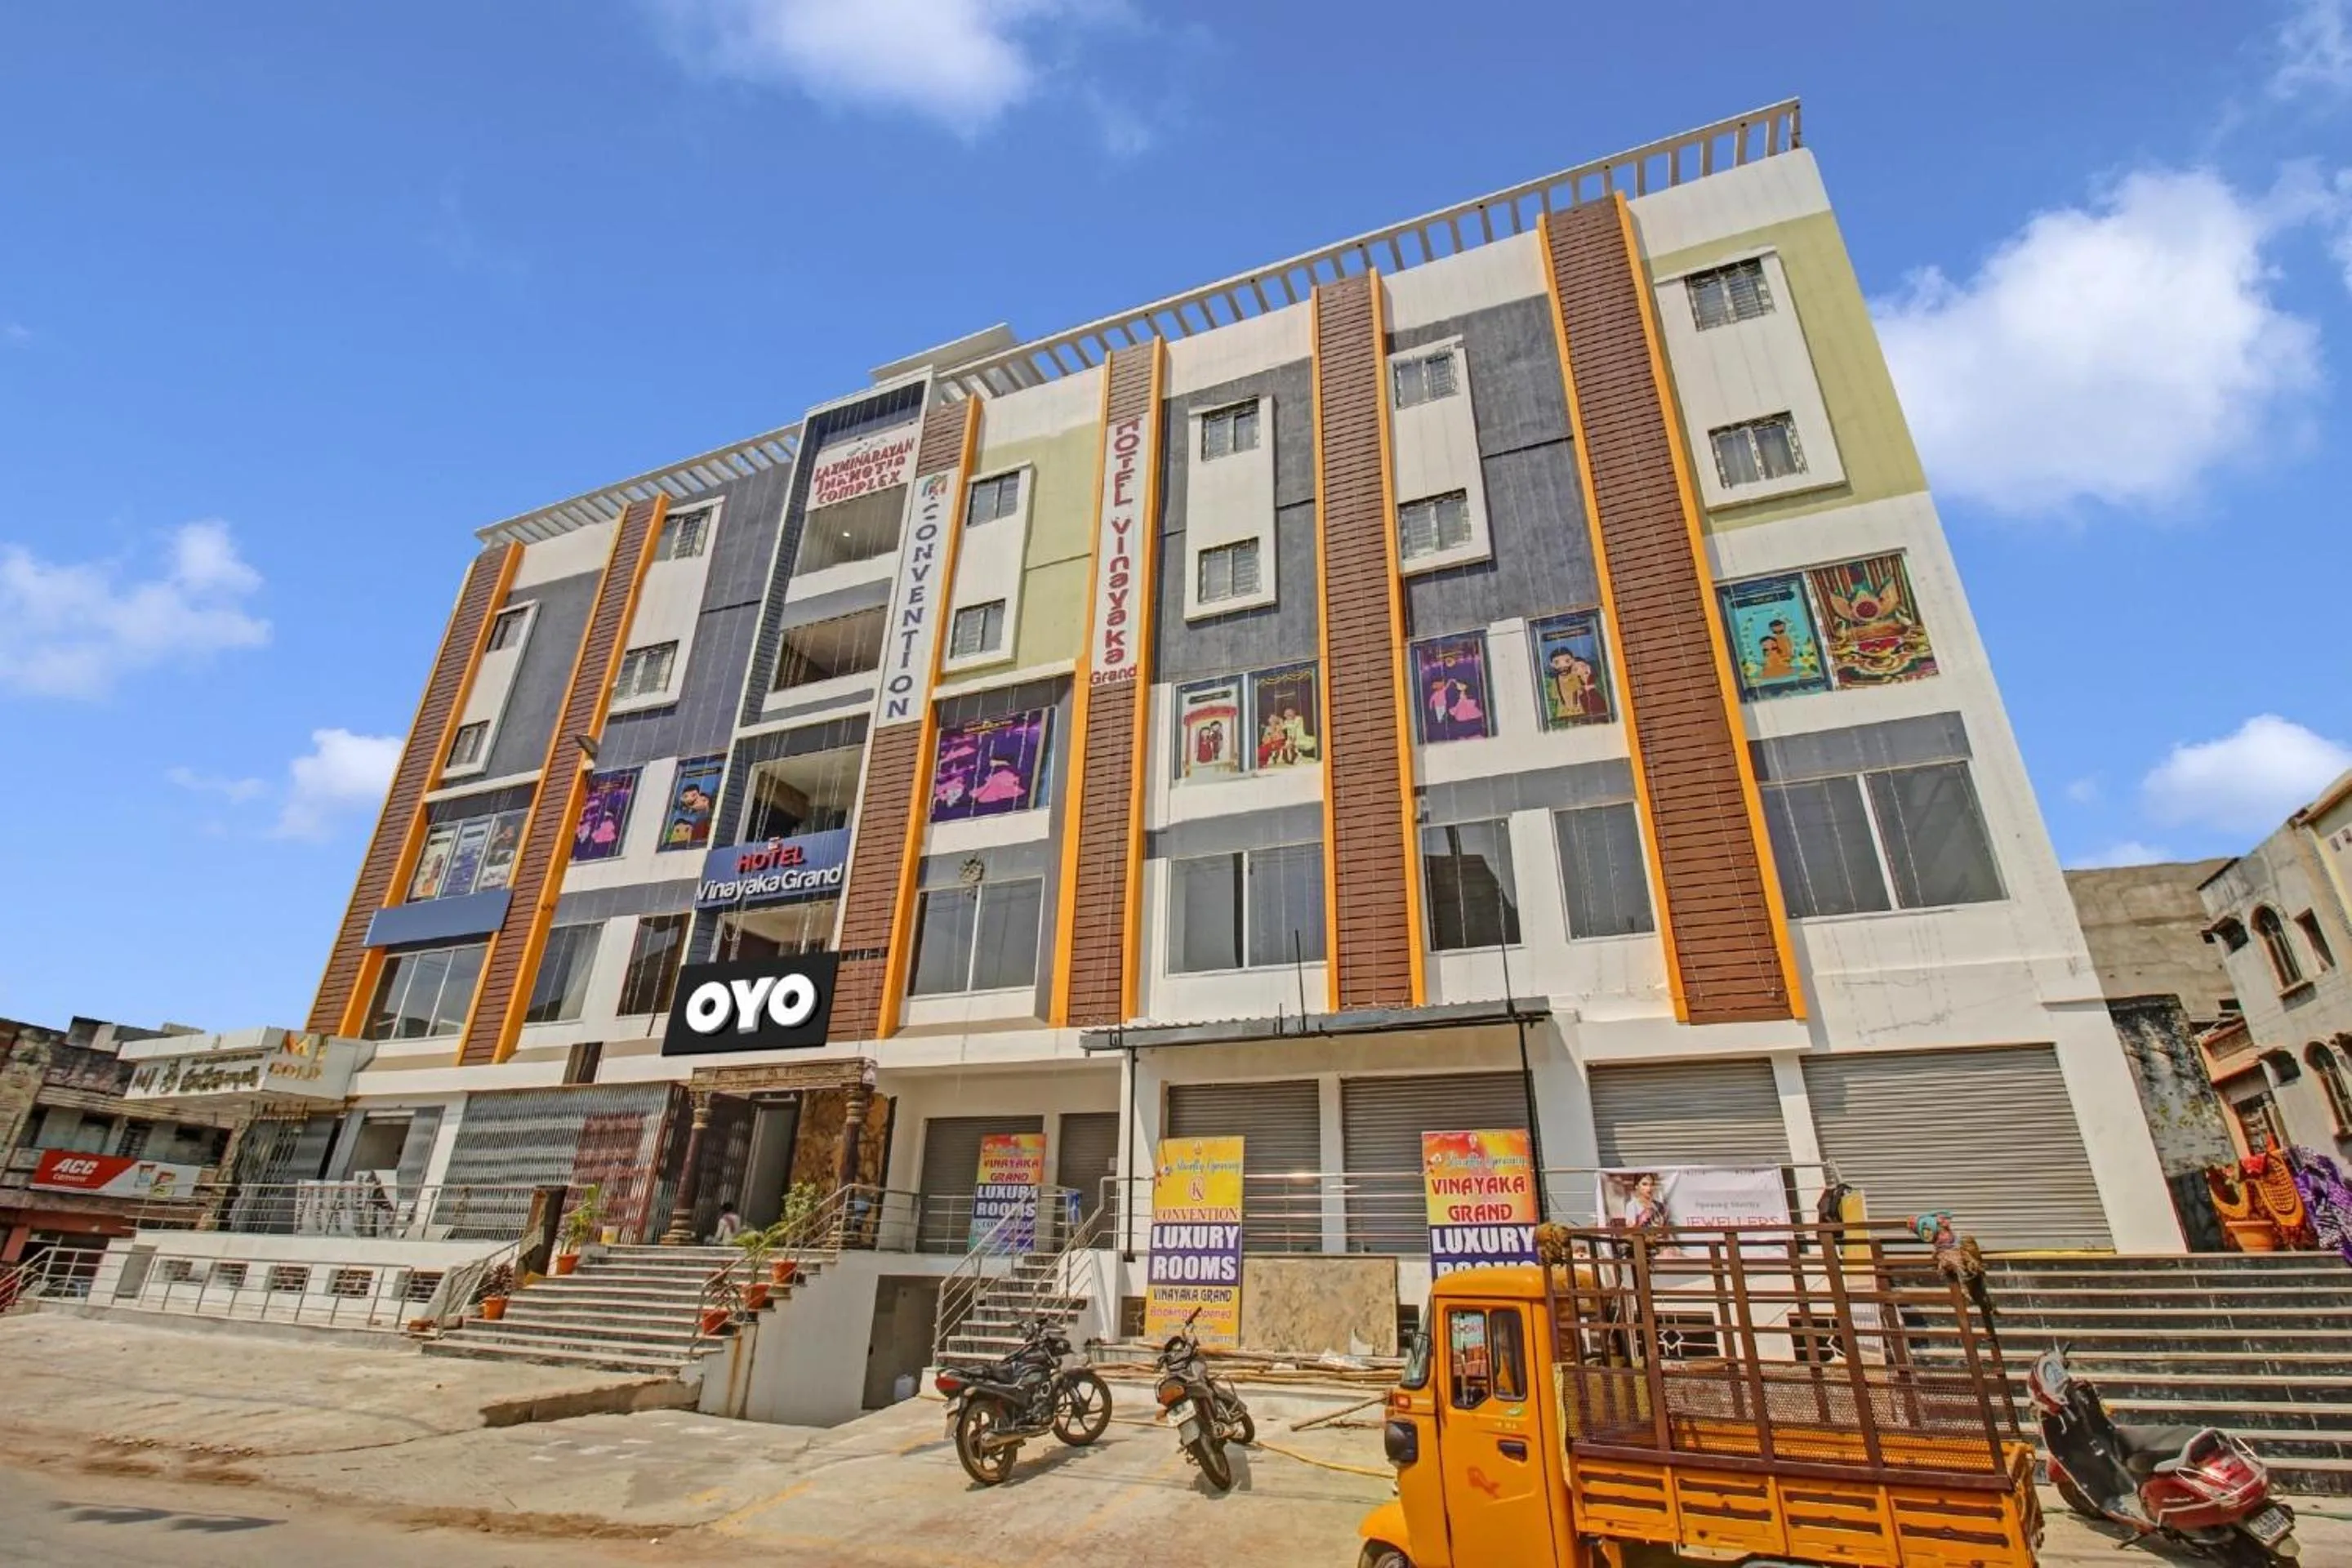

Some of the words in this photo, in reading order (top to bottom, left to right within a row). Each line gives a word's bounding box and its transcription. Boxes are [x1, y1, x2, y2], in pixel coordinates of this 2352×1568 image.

[817, 470, 901, 505] COMPLEX
[1090, 665, 1138, 685] Grand
[737, 845, 804, 873] HOTEL
[695, 874, 780, 901] Vinayaka
[782, 862, 844, 890] Grand
[686, 973, 817, 1035] OYO
[52, 1158, 99, 1175] ACC
[991, 1172, 1029, 1182] GRAND
[1431, 1176, 1525, 1196] VINAYAKA
[1155, 1207, 1239, 1221] CONVENTION
[1448, 1204, 1512, 1222] GRAND
[1152, 1226, 1240, 1249] LUXURY
[1432, 1227, 1536, 1254] LUXURY
[1152, 1255, 1236, 1281] ROOMS
[1154, 1288, 1199, 1301] VINAYAKA
[1200, 1290, 1232, 1303] GRAND
